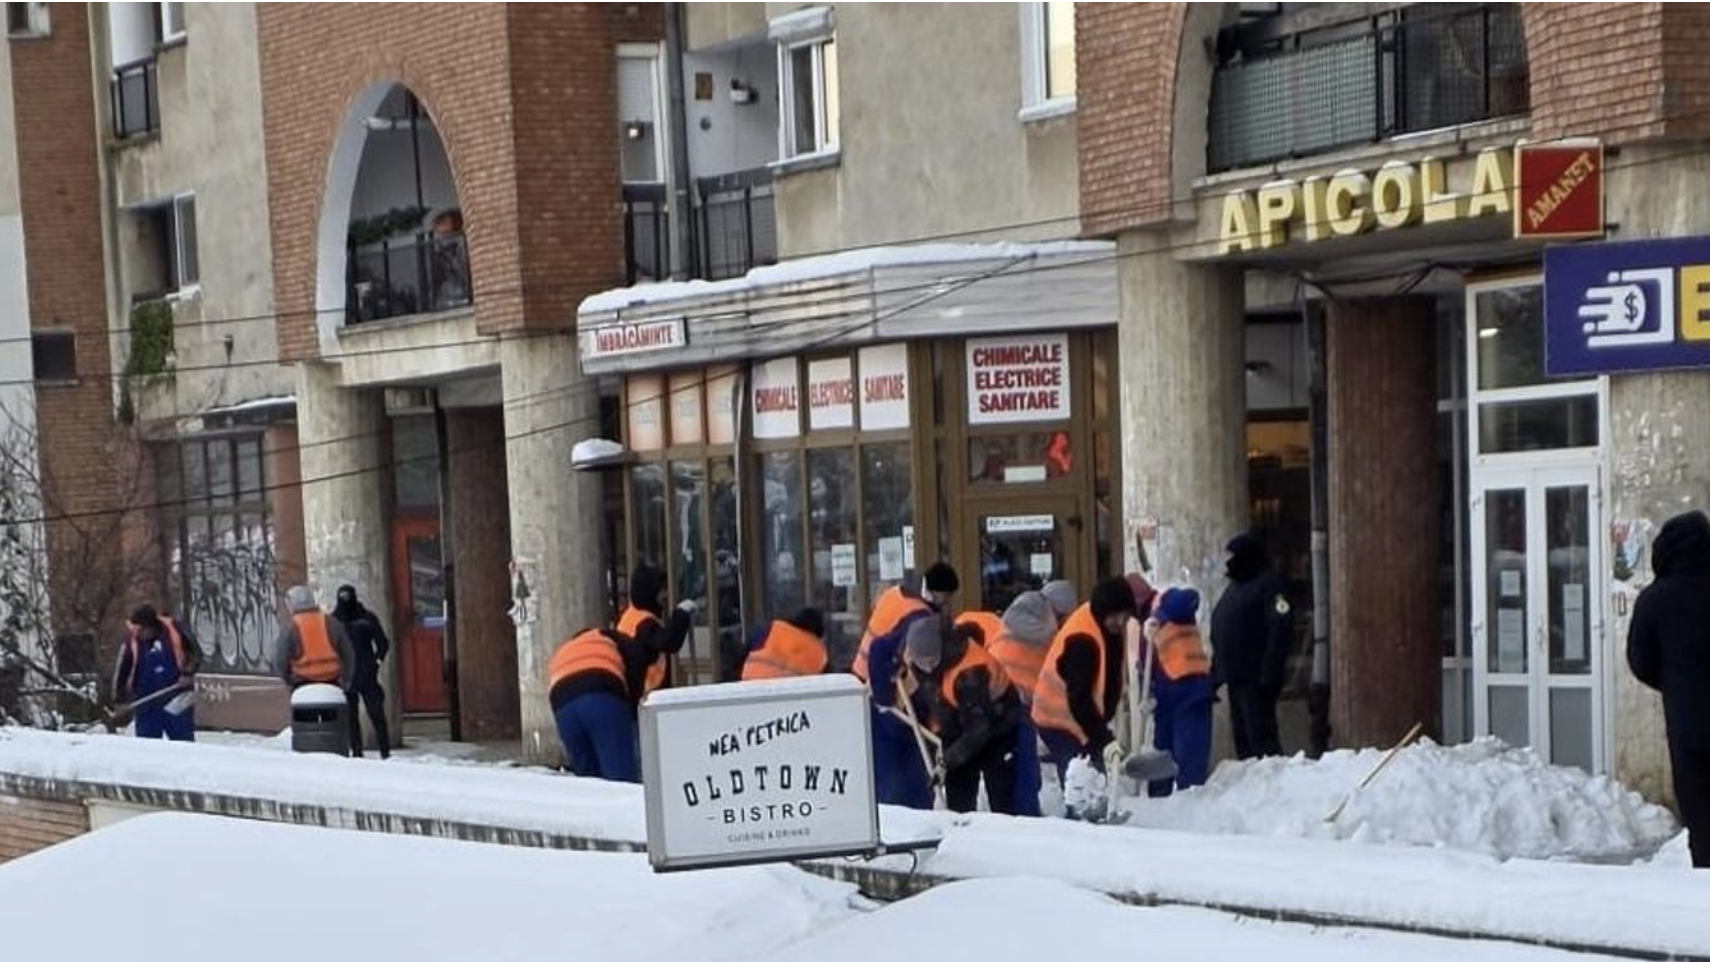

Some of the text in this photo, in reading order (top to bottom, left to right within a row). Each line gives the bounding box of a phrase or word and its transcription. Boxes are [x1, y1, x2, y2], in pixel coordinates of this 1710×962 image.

[1219, 148, 1513, 255] APICOLA
[1527, 151, 1595, 229] AMANET
[973, 343, 1062, 367] CHIMICALE
[756, 386, 796, 413] CHIMICALE
[865, 374, 905, 402] SANITARE
[975, 367, 1062, 390] ELECTRICE
[979, 390, 1060, 413] SANITARE
[746, 710, 810, 746] PETRICA
[683, 764, 848, 807] OLDTOWN
[723, 801, 812, 824] BISTRO
